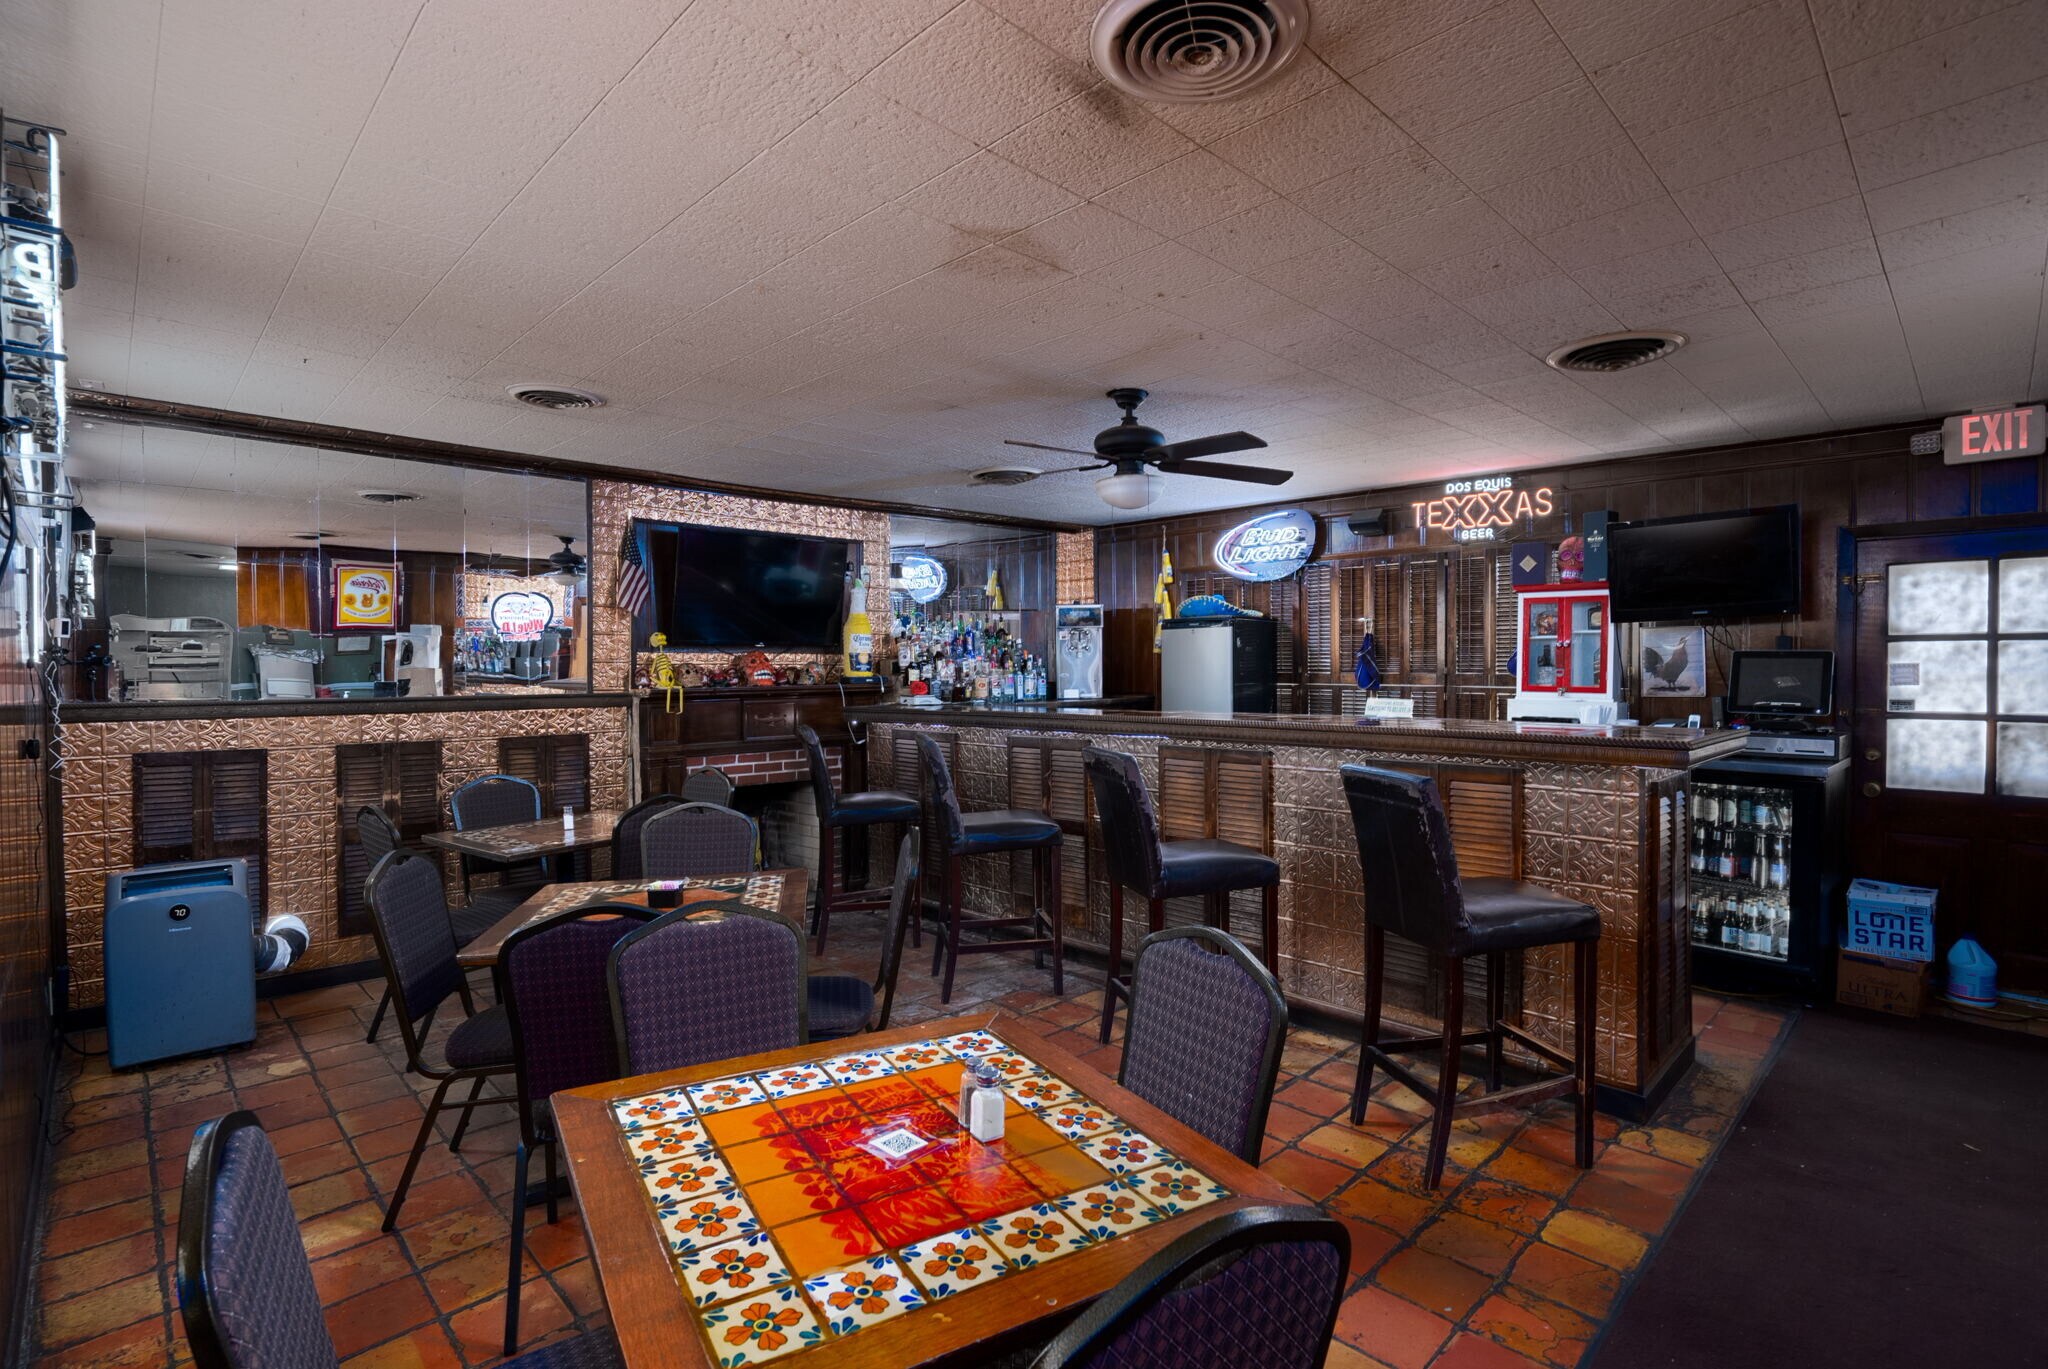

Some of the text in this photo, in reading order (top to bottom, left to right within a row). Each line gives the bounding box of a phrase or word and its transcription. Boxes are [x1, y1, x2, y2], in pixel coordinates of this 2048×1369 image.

[1962, 409, 2033, 456] EXIT
[1446, 477, 1512, 494] DOS EQUIS
[1412, 488, 1553, 529] TEXXAS
[1241, 527, 1299, 546] BUD
[1461, 528, 1495, 539] BEER
[1228, 543, 1307, 564] LIGHT
[174, 908, 186, 916] 70
[1854, 910, 1924, 933] LONE
[1854, 928, 1925, 952] STAR
